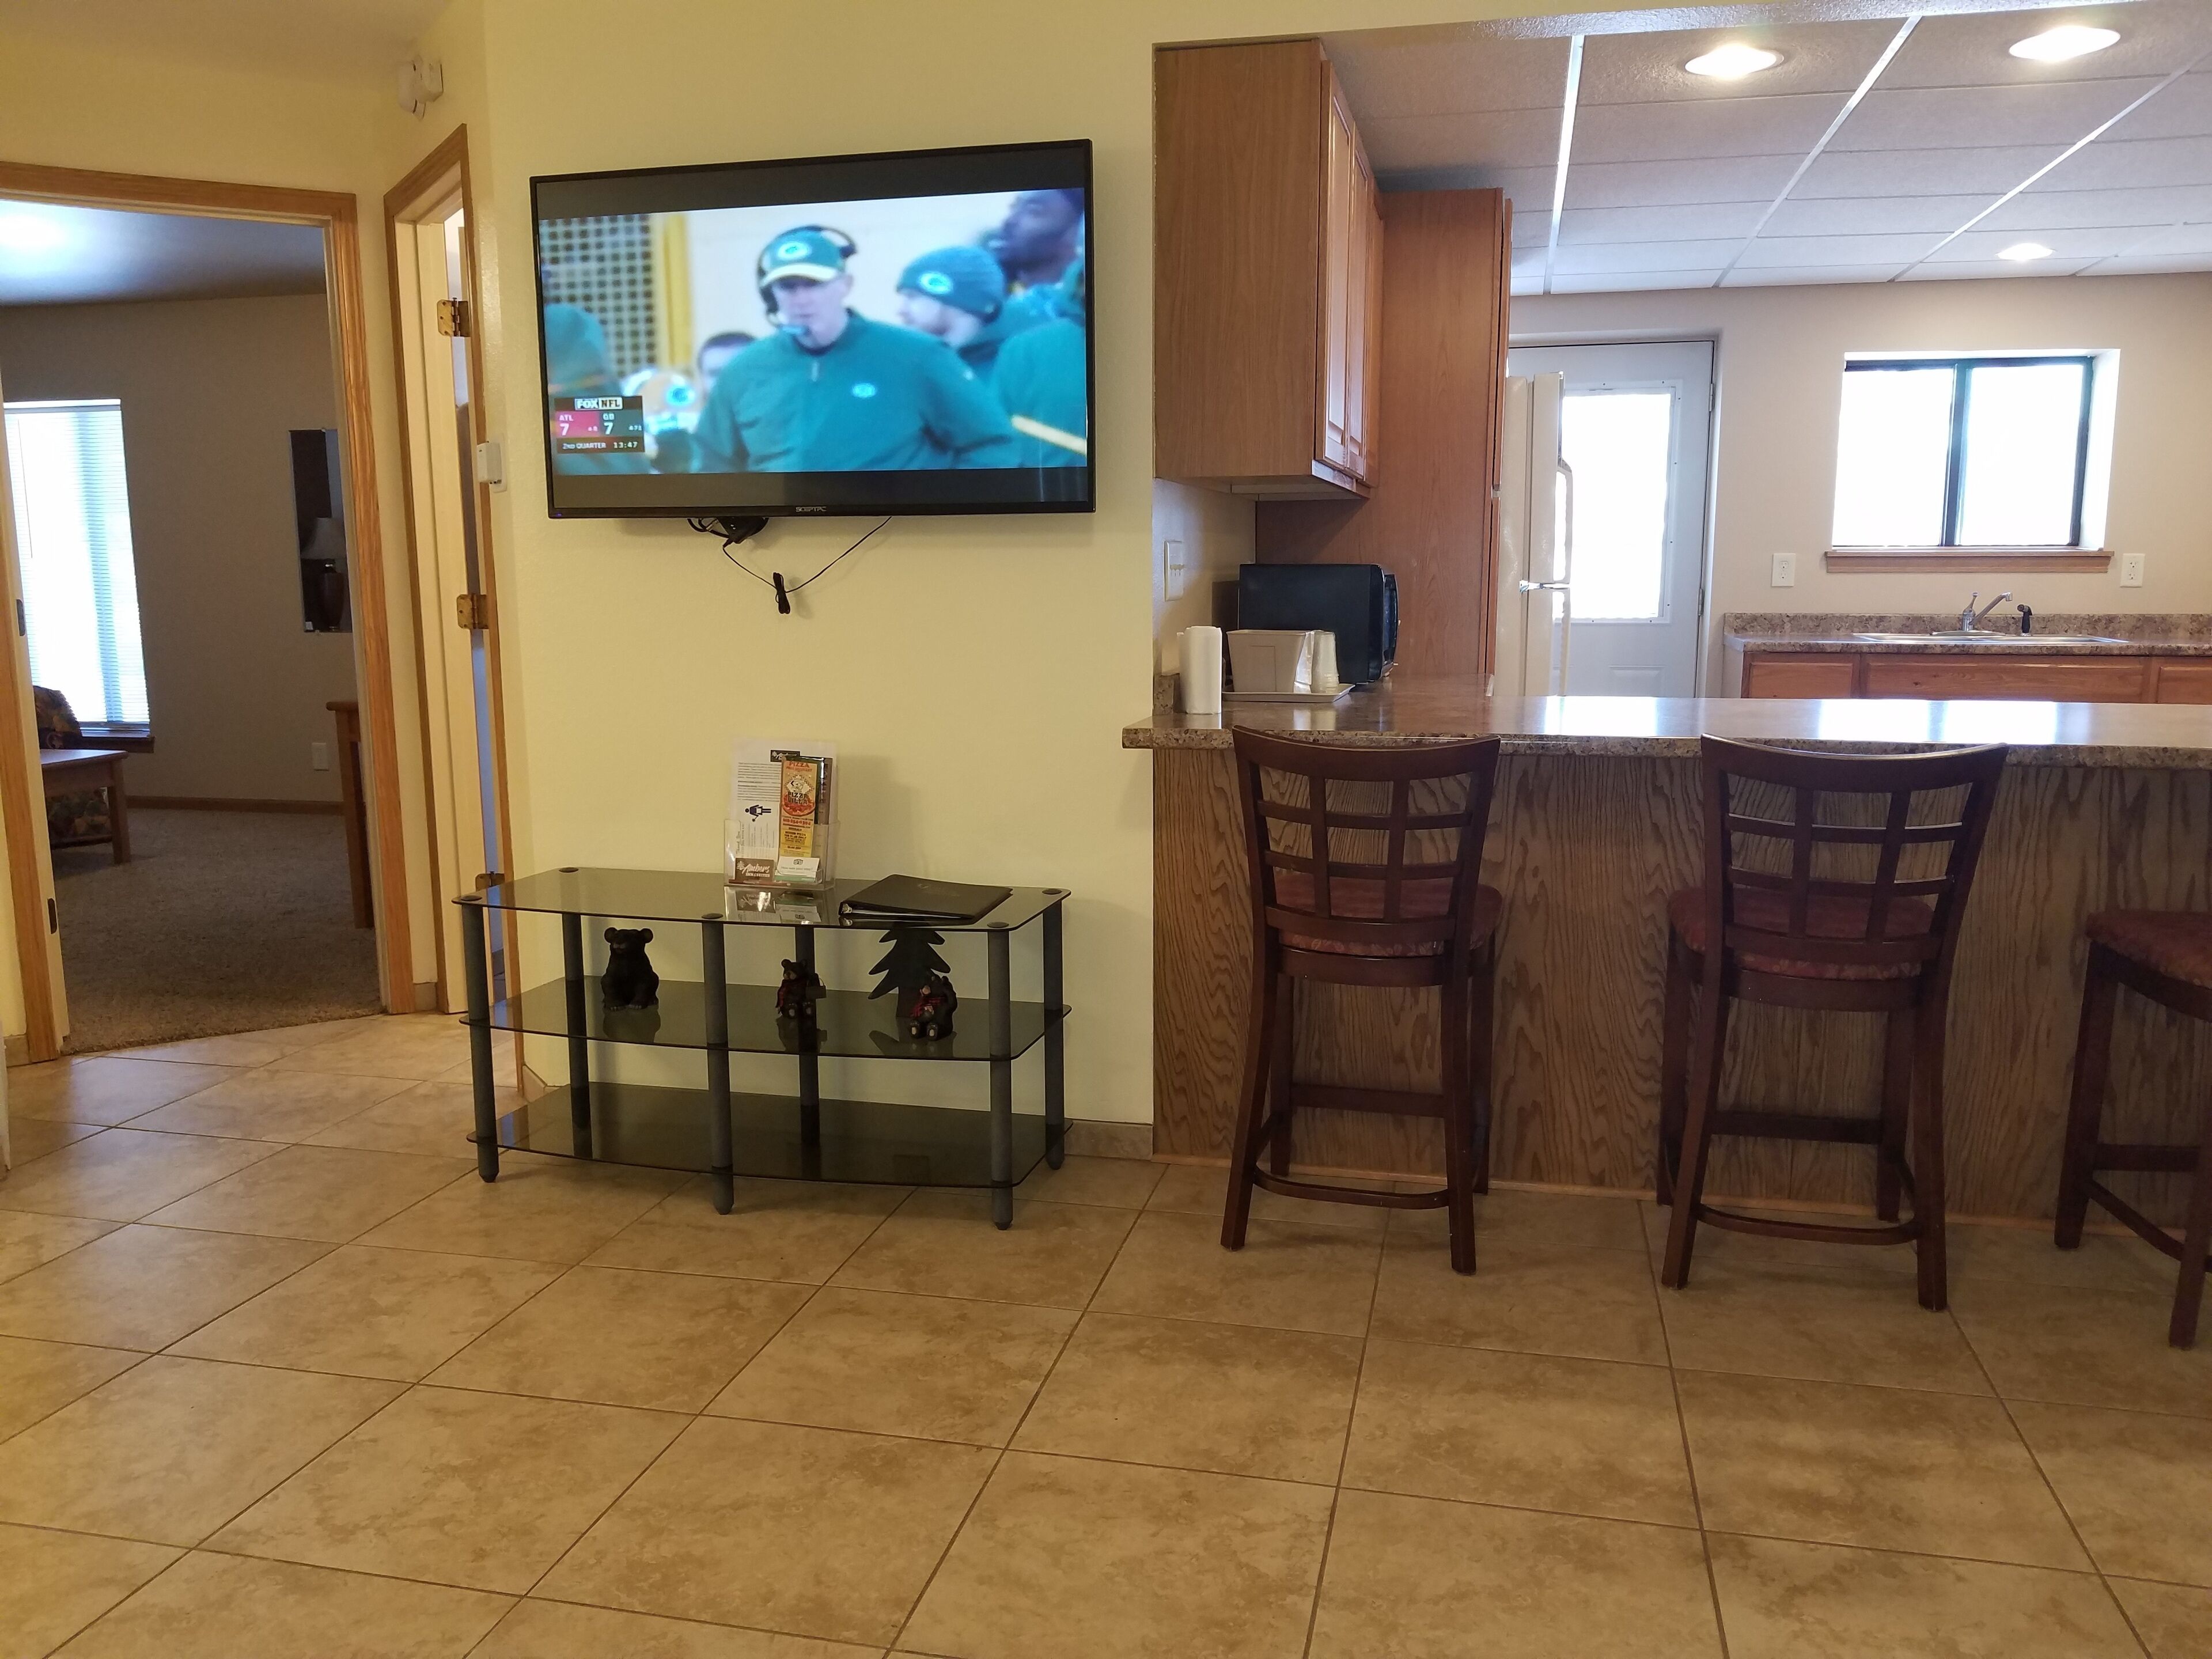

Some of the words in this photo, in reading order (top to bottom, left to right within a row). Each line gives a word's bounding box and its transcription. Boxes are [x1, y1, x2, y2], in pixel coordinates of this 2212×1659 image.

[577, 399, 599, 409] FOX
[601, 399, 620, 408] NFL
[559, 423, 570, 436] 7
[603, 422, 613, 435] 7
